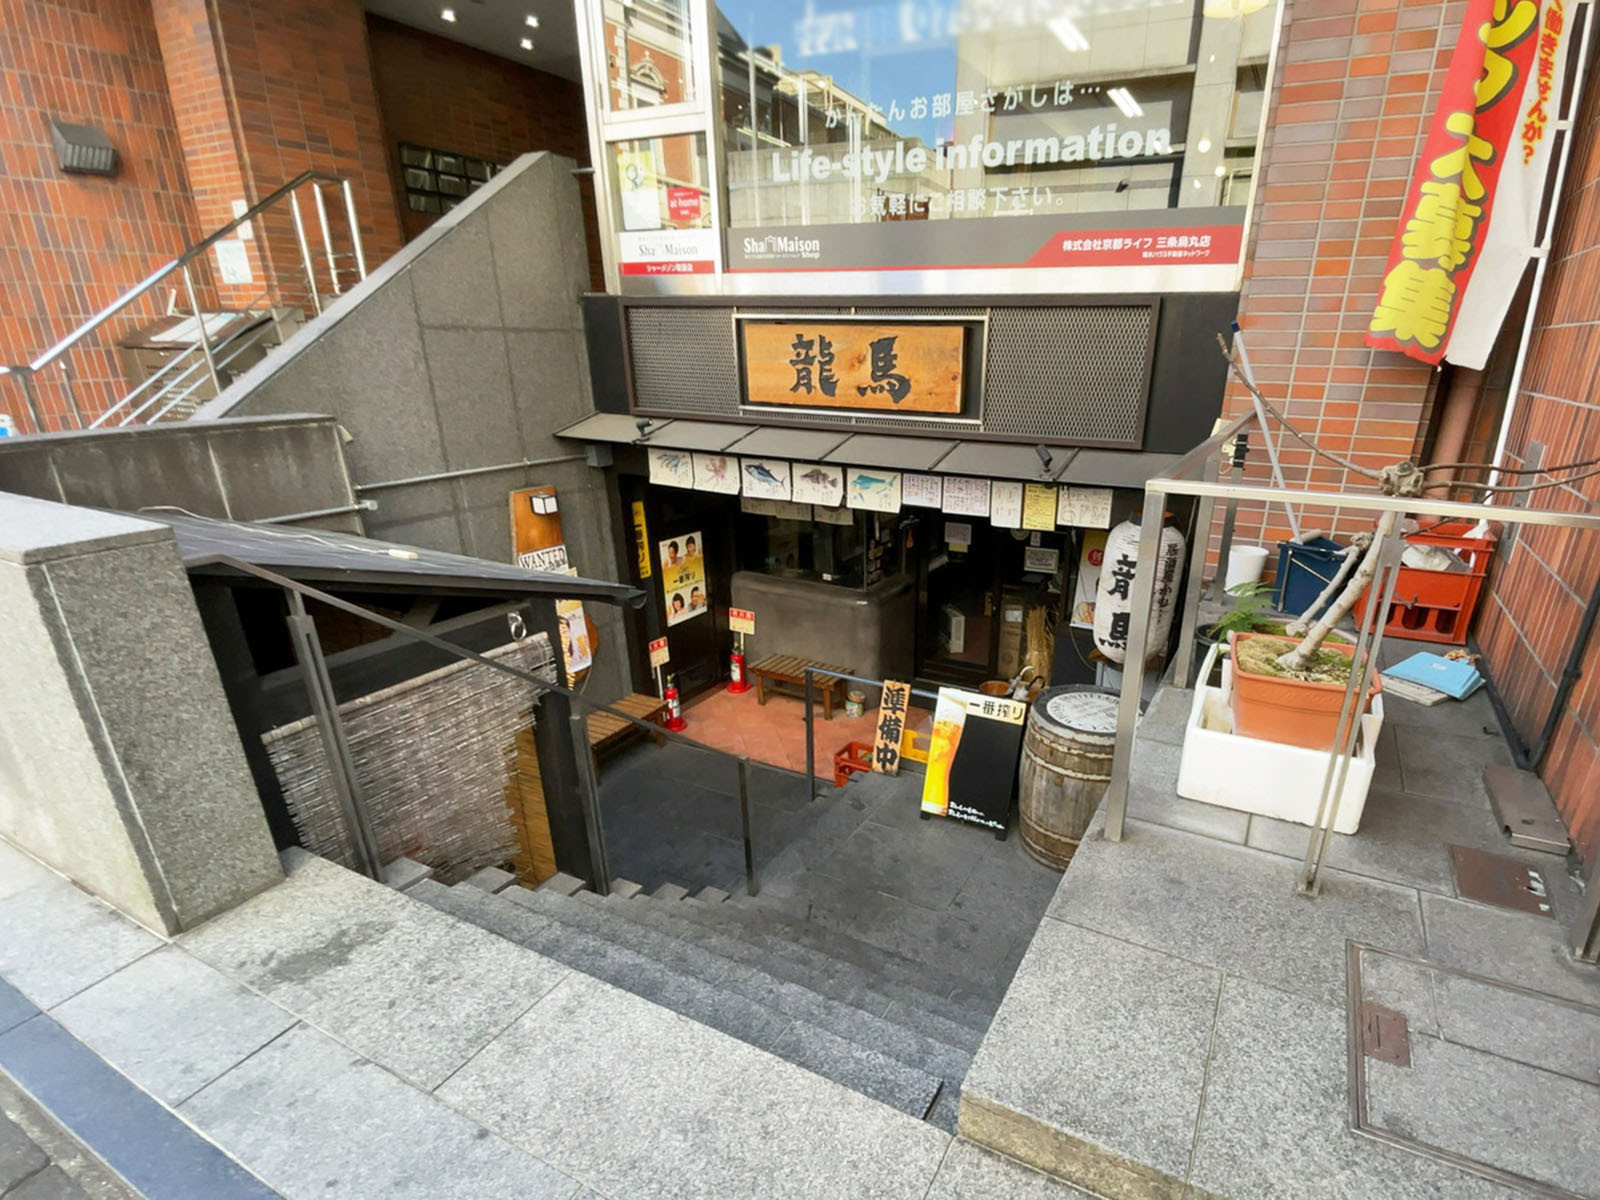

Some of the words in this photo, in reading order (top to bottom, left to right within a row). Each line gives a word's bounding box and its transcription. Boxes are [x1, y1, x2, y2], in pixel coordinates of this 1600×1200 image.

[1522, 0, 1564, 165] 働きませんか?
[772, 142, 926, 184] Life-style
[936, 124, 1172, 170] information
[1062, 237, 1153, 251] 株式会社京都ライフ
[789, 333, 912, 404] 龍馬
[519, 547, 567, 570] WANTED
[875, 686, 906, 770] 準備中
[968, 701, 1024, 721] 一番搾り
